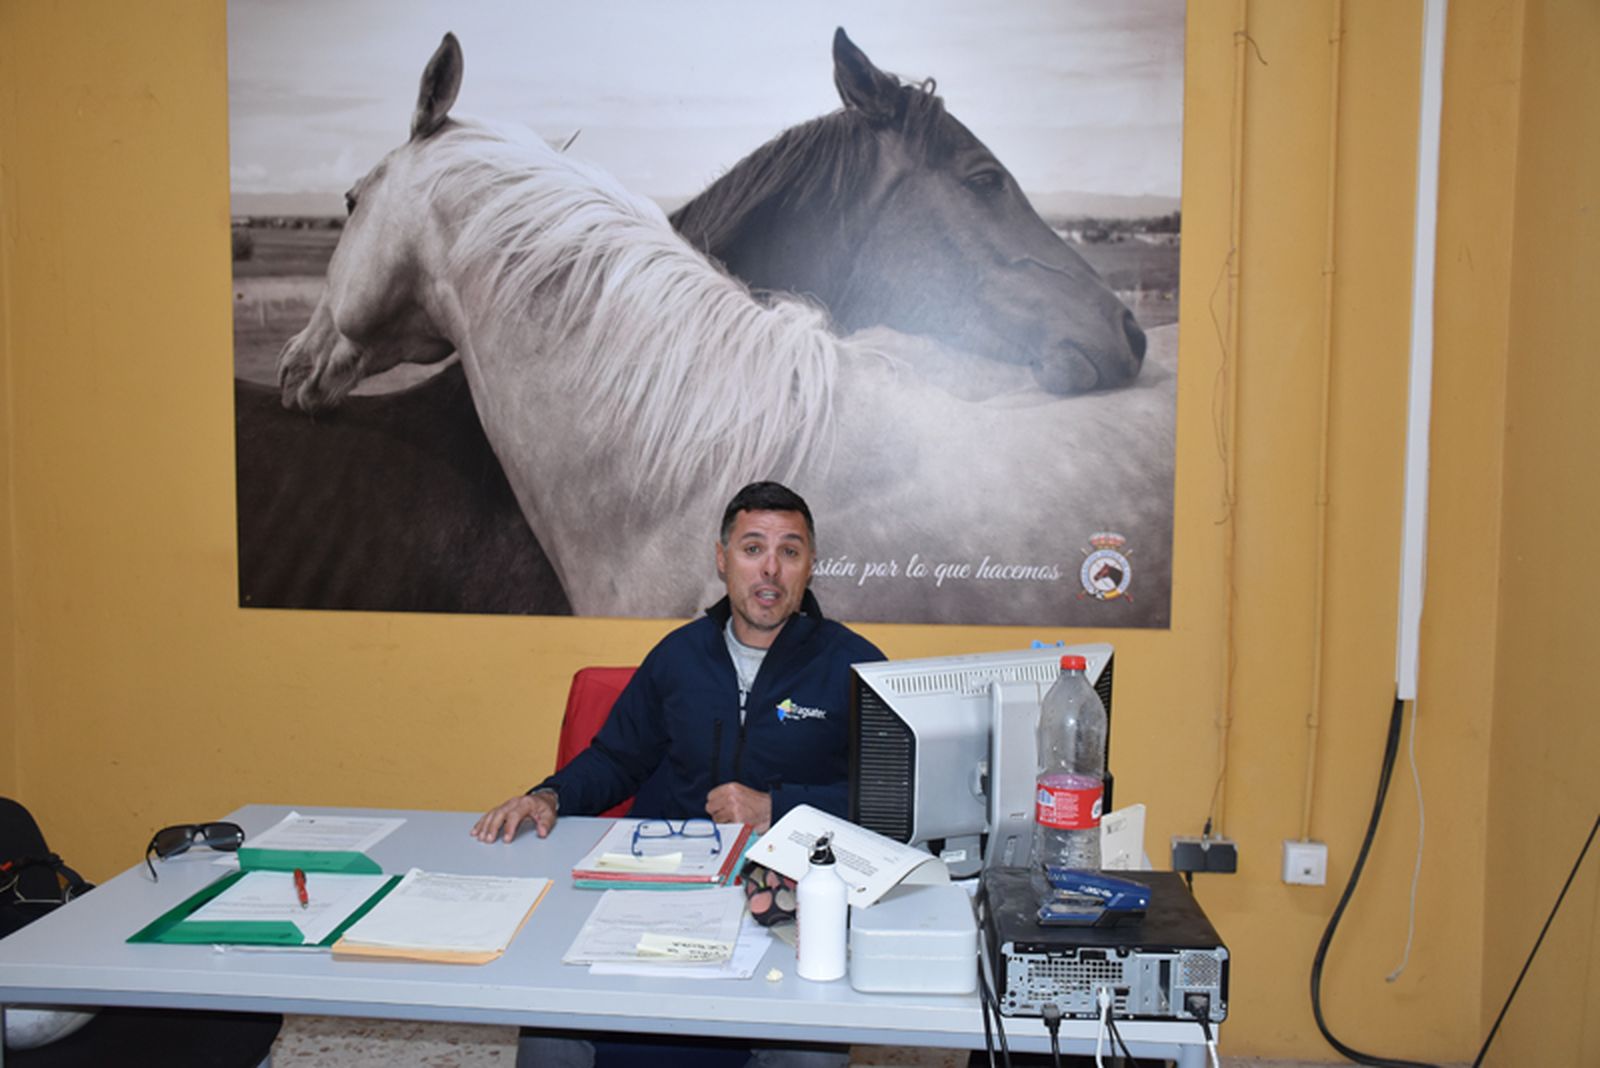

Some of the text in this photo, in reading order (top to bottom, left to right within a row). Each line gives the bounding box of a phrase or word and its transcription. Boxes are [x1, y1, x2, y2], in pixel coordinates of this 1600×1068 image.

[811, 553, 1061, 587] sión por lo que hacemos
